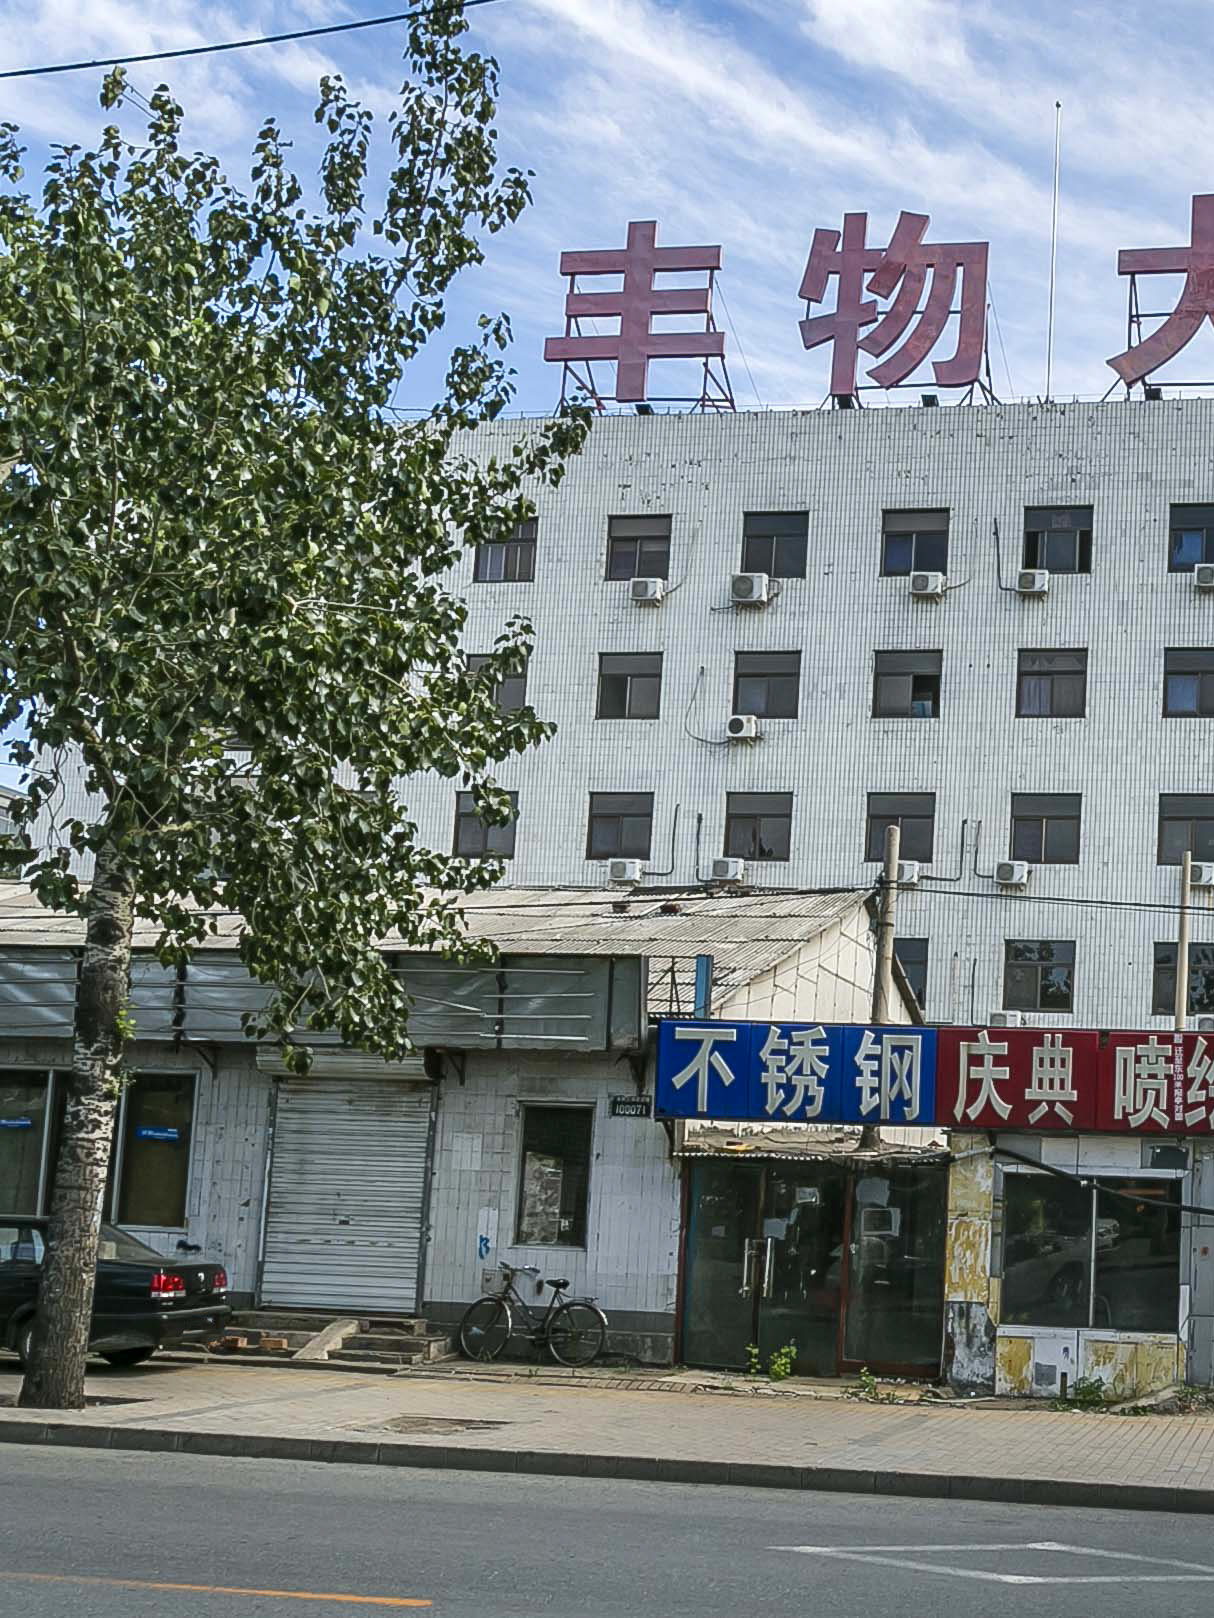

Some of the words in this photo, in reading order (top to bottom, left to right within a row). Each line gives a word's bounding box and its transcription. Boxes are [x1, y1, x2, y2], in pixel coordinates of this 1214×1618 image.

[671, 1025, 923, 1121] 不锈钢
[953, 1029, 1079, 1125] 庆典
